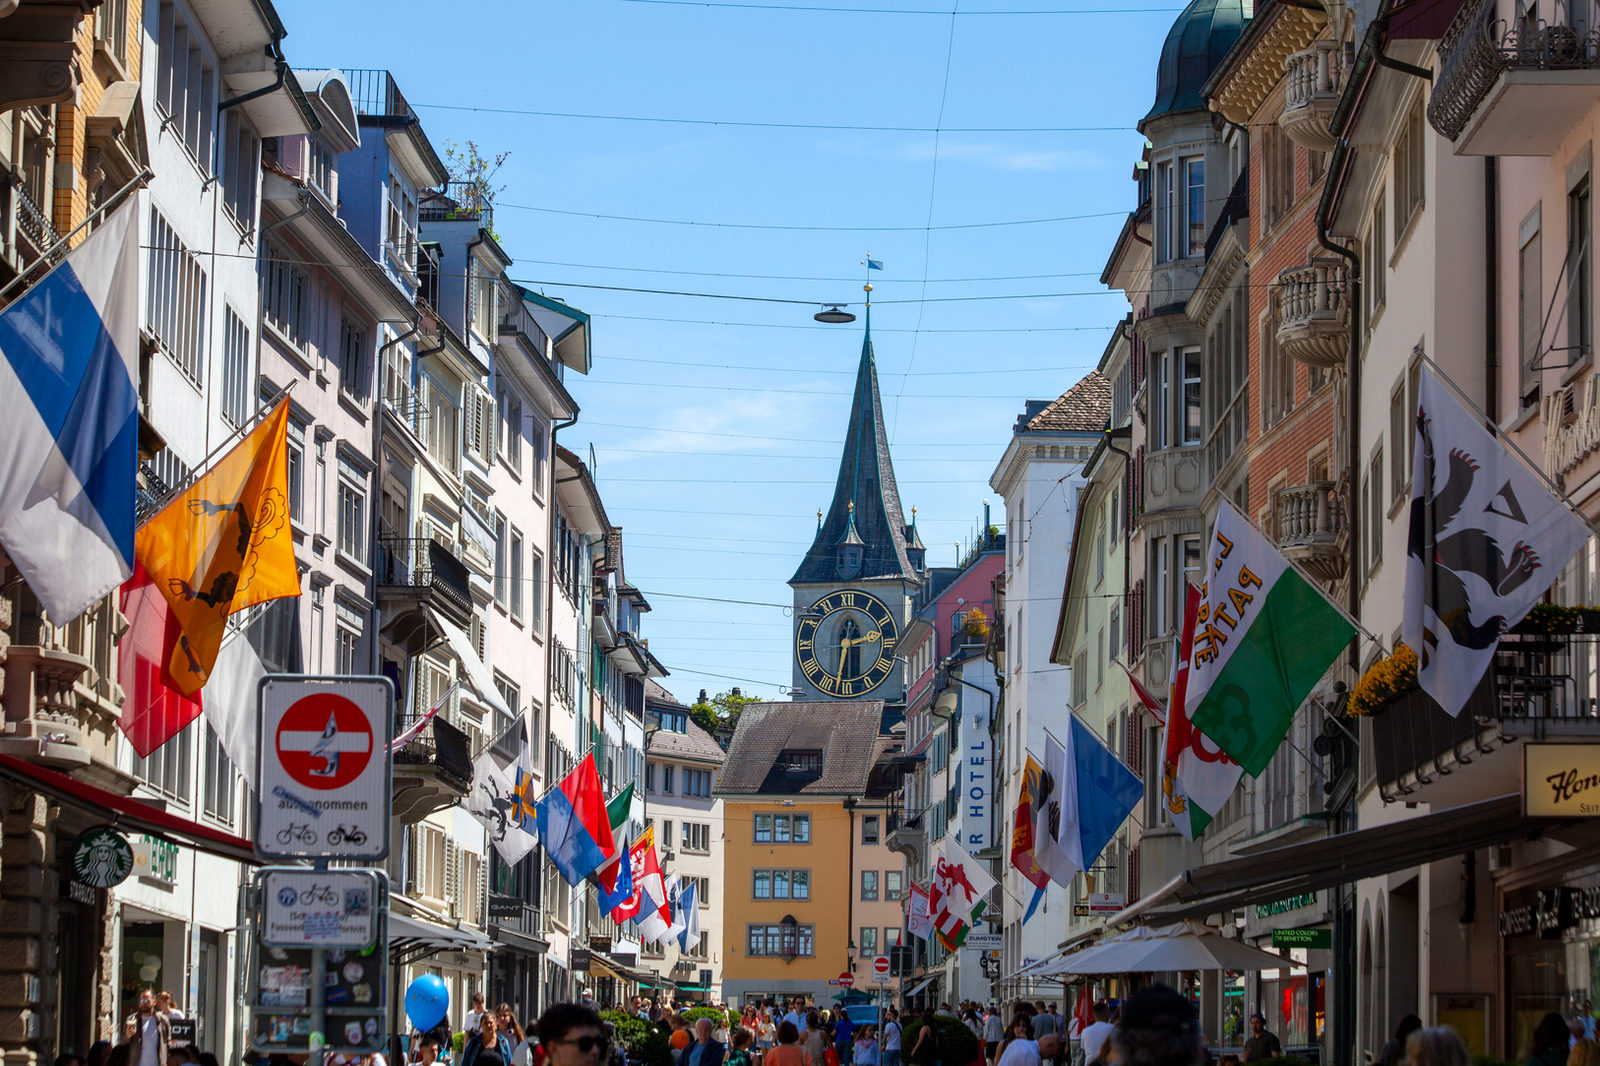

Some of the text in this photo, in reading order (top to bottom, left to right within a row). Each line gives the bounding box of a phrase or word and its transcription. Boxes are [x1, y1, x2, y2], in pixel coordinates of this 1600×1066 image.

[969, 741, 985, 817] HOTEL
[1546, 768, 1600, 804] Hon
[278, 799, 368, 811] aunommen
